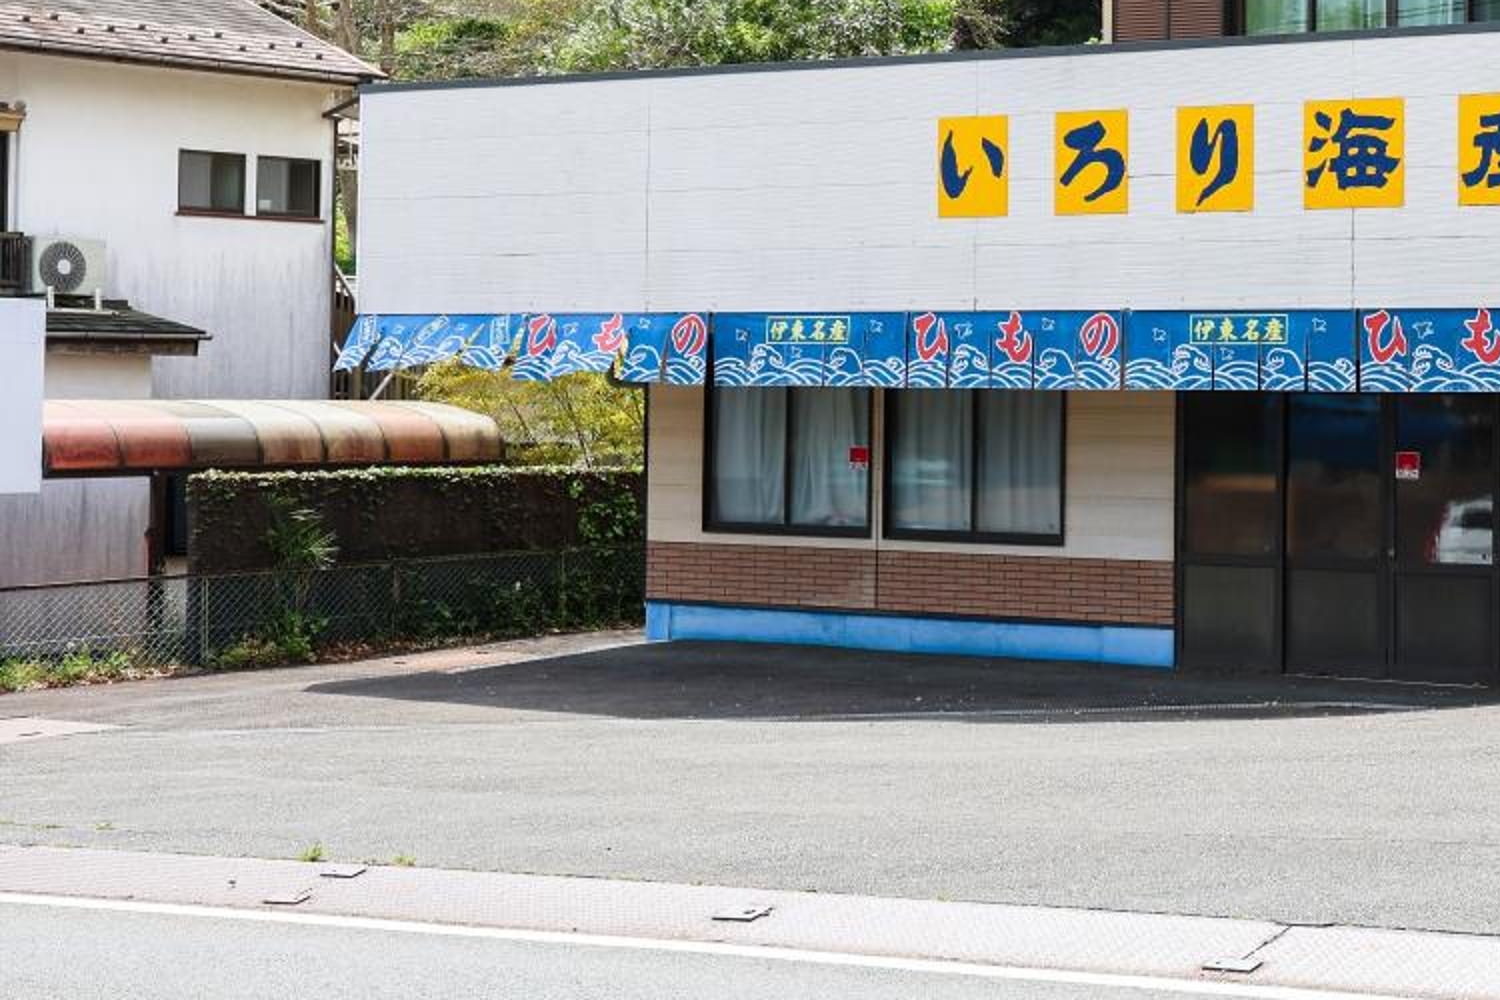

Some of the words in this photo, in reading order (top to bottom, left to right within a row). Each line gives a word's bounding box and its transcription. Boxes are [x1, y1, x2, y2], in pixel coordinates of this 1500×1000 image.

[527, 313, 705, 357] ひもの
[769, 318, 848, 342] 伊東名産
[913, 312, 1120, 362] ひもの
[1193, 318, 1285, 341] 伊東名産
